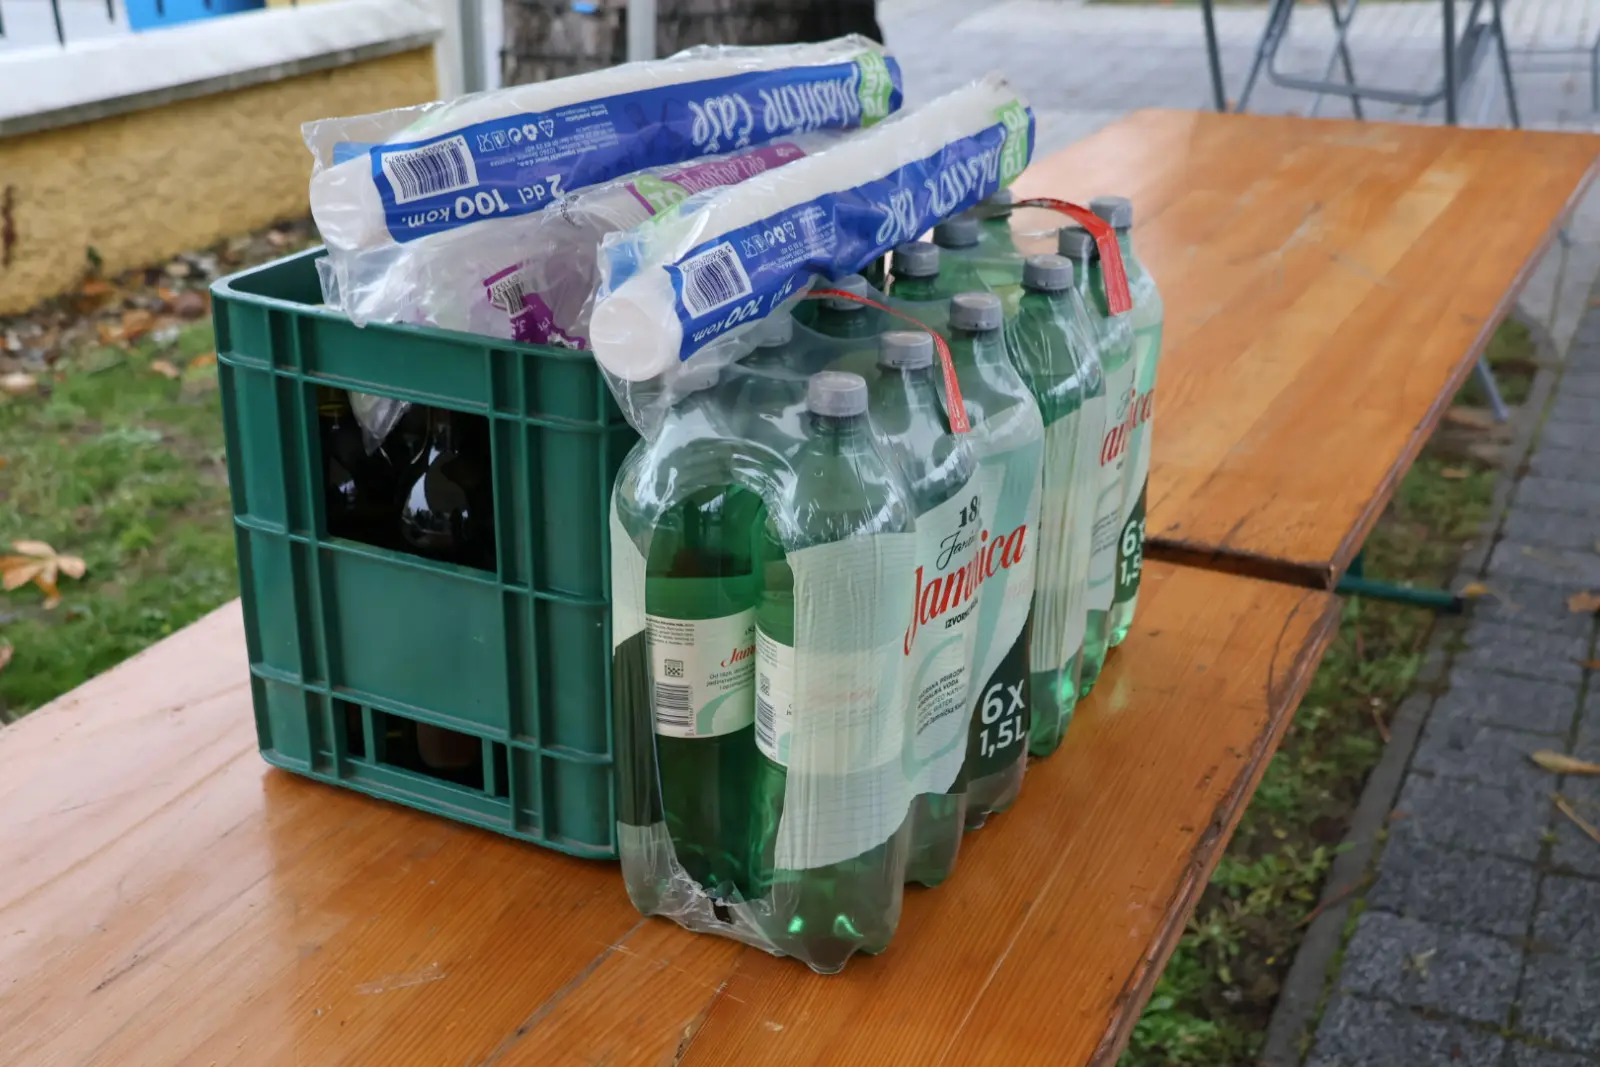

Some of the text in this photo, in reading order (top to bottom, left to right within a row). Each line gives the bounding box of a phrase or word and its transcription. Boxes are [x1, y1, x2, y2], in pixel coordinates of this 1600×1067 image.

[687, 92, 754, 154] čaše
[401, 173, 565, 229] 2 dcl 100 kom.
[692, 320, 726, 343] kom.
[723, 295, 764, 329] 100
[979, 715, 1026, 758] 1,5L
